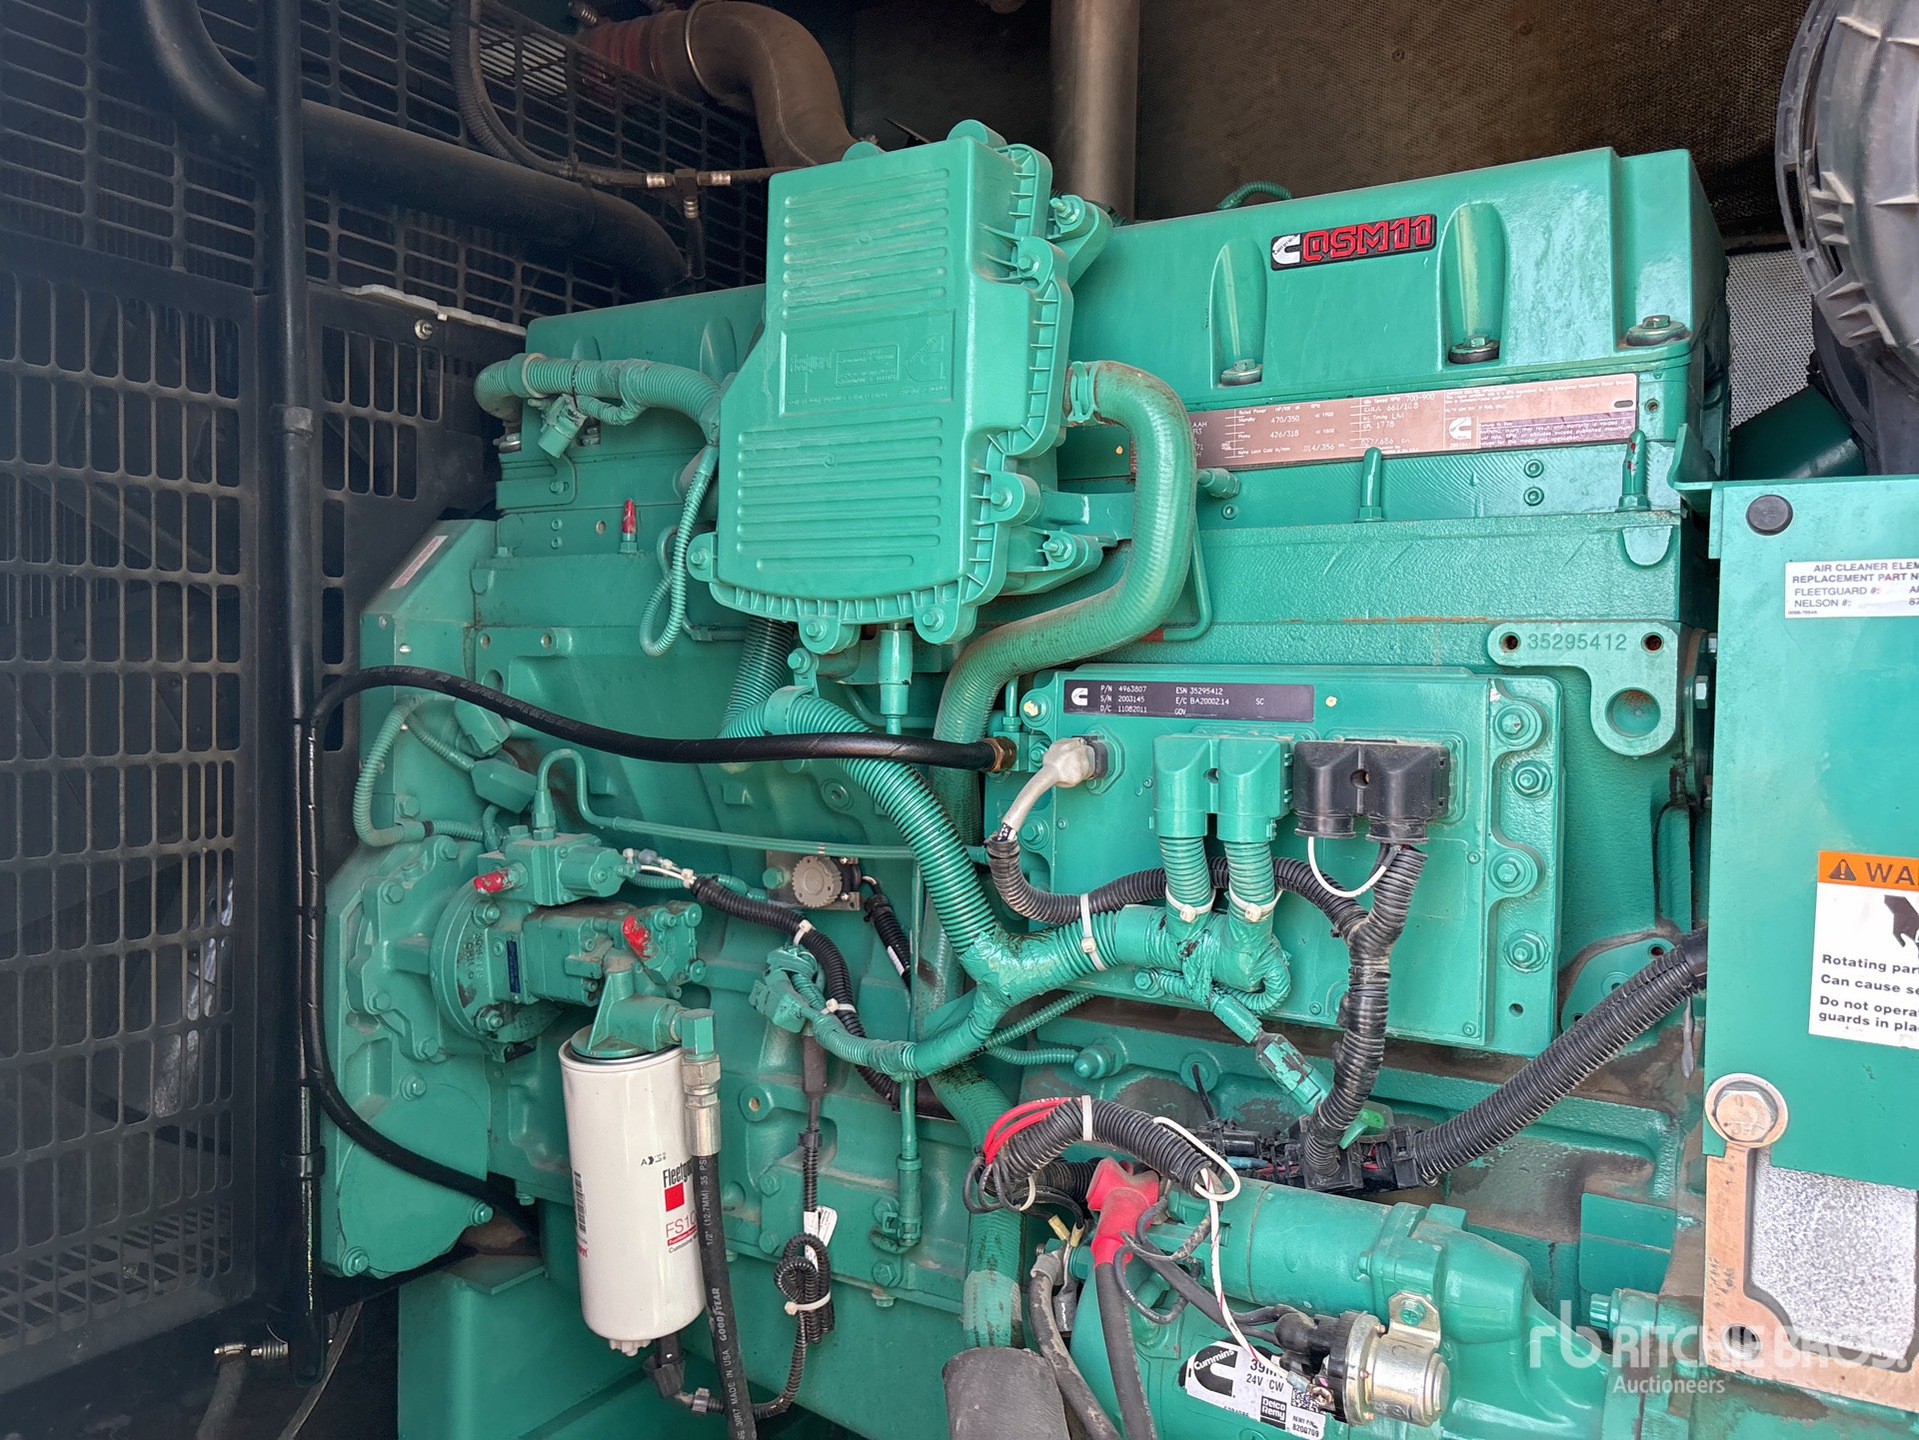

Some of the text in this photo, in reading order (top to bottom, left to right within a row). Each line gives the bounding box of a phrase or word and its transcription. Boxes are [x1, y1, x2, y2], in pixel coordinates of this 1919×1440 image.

[1303, 214, 1431, 262] QSM11
[1406, 393, 1436, 403] 700-900
[1271, 414, 1300, 424] 470/350
[1376, 420, 1395, 429] 1778
[1270, 428, 1299, 439] 426/318
[1813, 564, 1832, 572] AIR
[1835, 562, 1888, 571] CLEANER
[1792, 573, 1874, 583] REPLACEMENT
[1878, 572, 1907, 582] PART
[1794, 586, 1867, 596] FLEETGUARD
[1870, 586, 1880, 594] #:
[1794, 599, 1839, 608] NELSON
[1842, 599, 1851, 607] #:
[1528, 633, 1627, 651] 35295412
[1100, 684, 1223, 695] P/N 4963807 ESN 35295412
[1100, 695, 1112, 703] S/N
[1118, 695, 1145, 703] 2003145
[1175, 697, 1188, 705] E/C
[1255, 697, 1265, 705] SC
[1100, 705, 1186, 716] D/C 11082011 GOV
[1865, 861, 1919, 887] WA
[1822, 954, 1887, 973] Rotating
[1820, 974, 1850, 987] Can
[1855, 979, 1900, 993] cause
[1819, 995, 1839, 1007] Do
[1844, 1001, 1869, 1011] not
[1818, 1011, 1870, 1026] guards
[1875, 1017, 1889, 1029] in
[701, 1175, 709, 1186] 35
[711, 1287, 728, 1342] GOODYEAR
[723, 1349, 731, 1367] USA
[1193, 1348, 1235, 1371] Cummins
[726, 1369, 734, 1379] IN
[1246, 1373, 1285, 1393] 24V CW
[728, 1382, 738, 1405] MADE
[1262, 1398, 1286, 1411] Delco
[732, 1409, 744, 1427] 30R7
[1261, 1405, 1286, 1421] Remy
